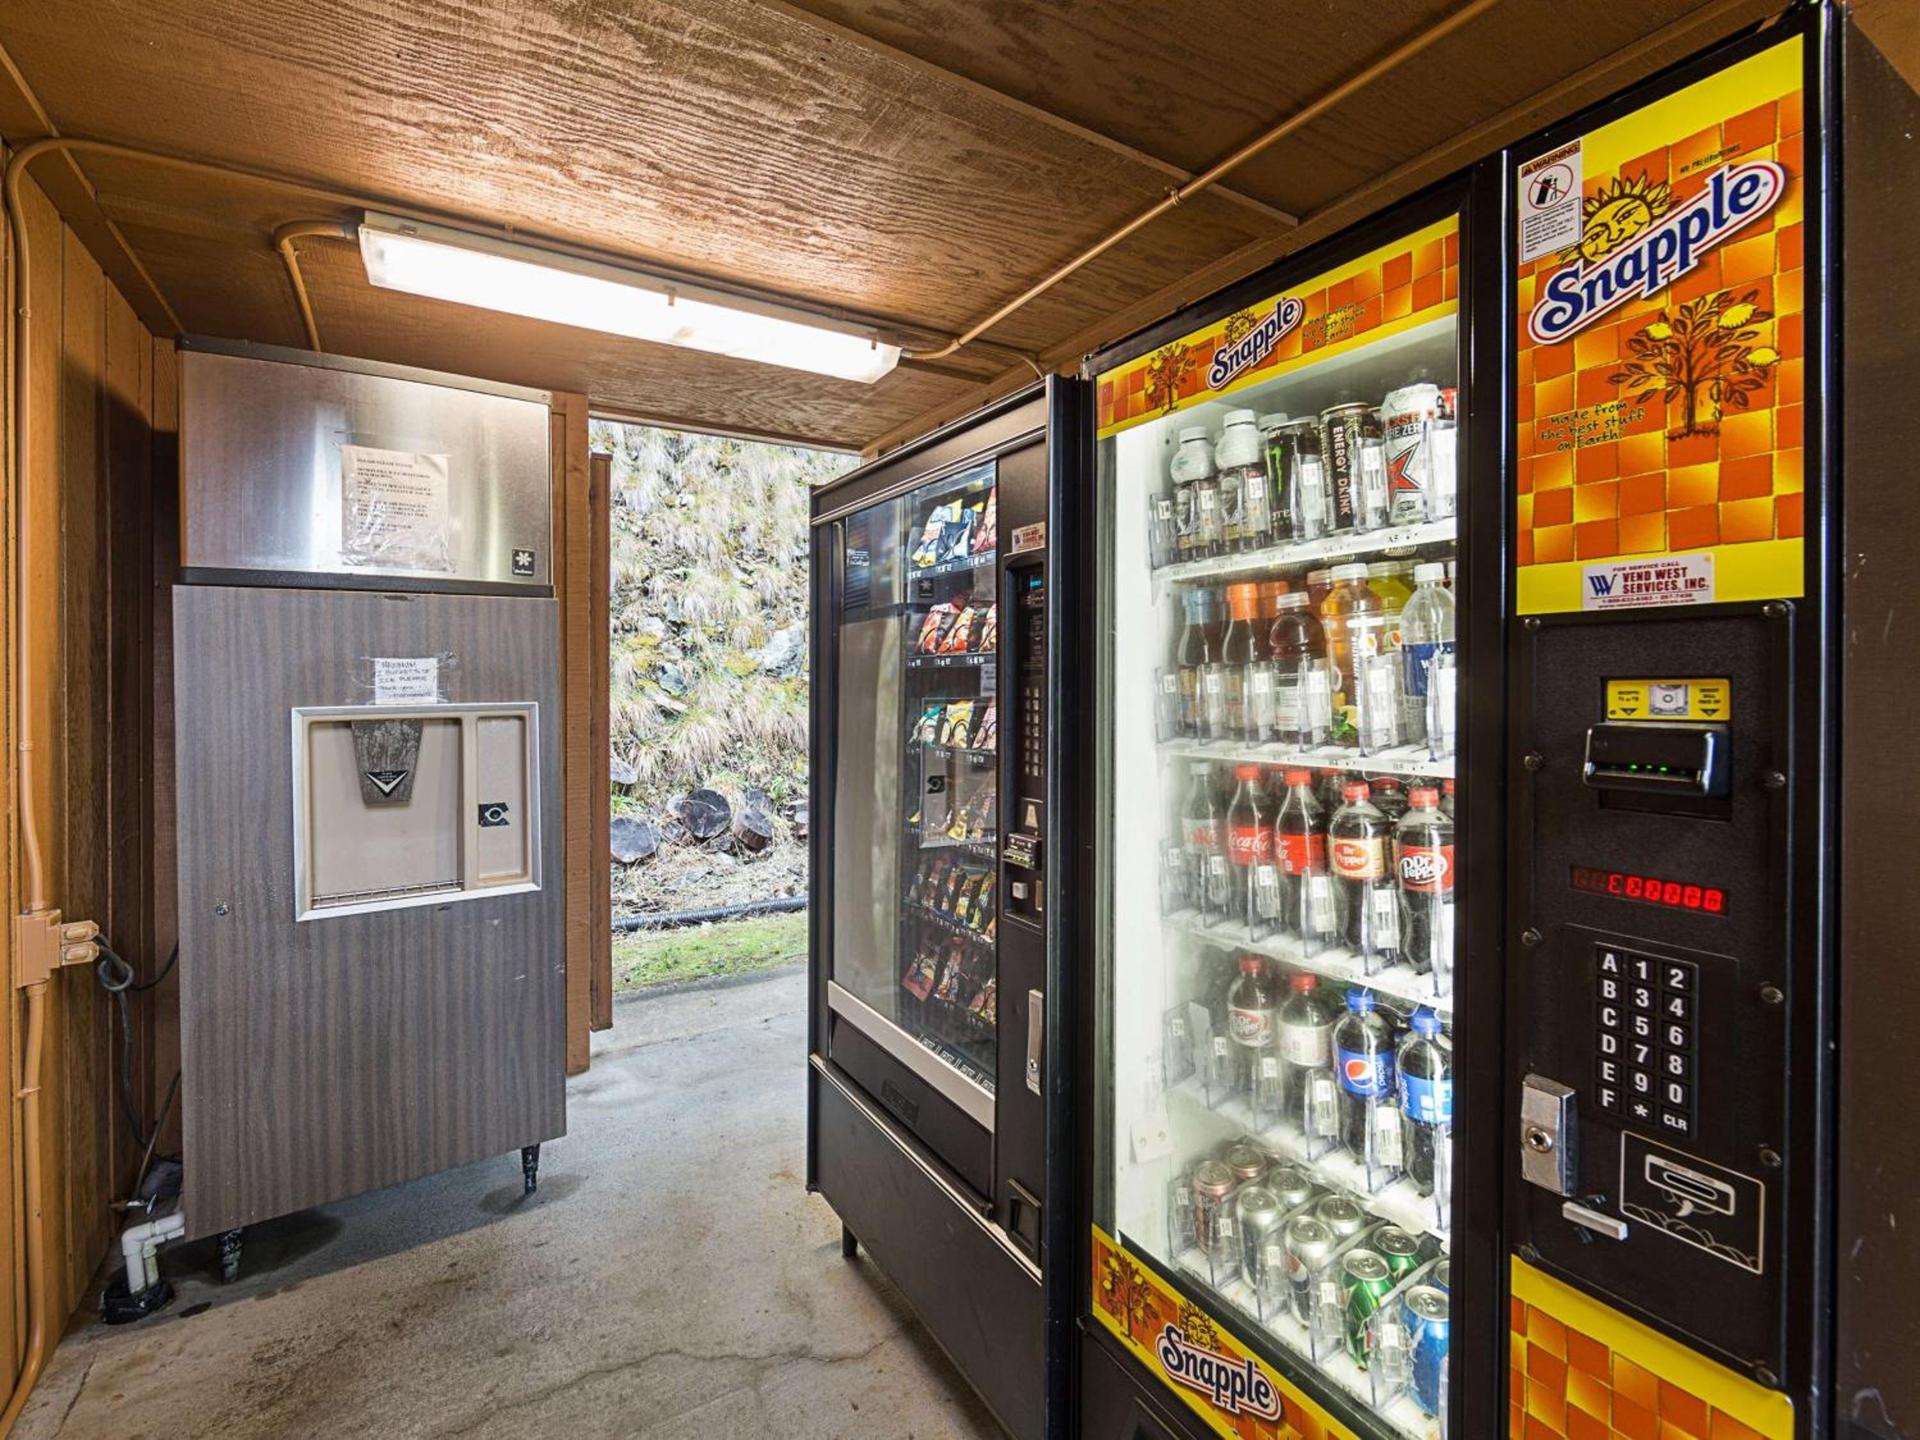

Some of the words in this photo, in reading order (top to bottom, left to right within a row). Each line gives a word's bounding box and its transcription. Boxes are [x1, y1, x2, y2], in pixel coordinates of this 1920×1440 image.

[1534, 141, 1580, 167] WARNING
[1541, 170, 1761, 333] Snapple
[1211, 300, 1296, 384] Snapple
[1541, 429, 1565, 440] the
[1567, 420, 1600, 436] best
[1604, 407, 1646, 429] stuff
[1550, 409, 1589, 425] Made
[1594, 401, 1628, 416] from
[1332, 425, 1348, 473] ENERGY
[1556, 441, 1573, 452] on
[1337, 478, 1352, 516] DRINK
[1622, 570, 1652, 583] VEND
[1655, 566, 1688, 581] WEST
[1684, 577, 1710, 590] INC.
[1602, 953, 1618, 973] A
[1635, 960, 1647, 980] 1
[1669, 968, 1685, 989] 2
[1602, 979, 1617, 999] B
[1635, 988, 1650, 1008] 3
[1669, 998, 1684, 1017] 4
[1602, 1007, 1617, 1027] C
[1635, 1016, 1649, 1036] 5
[1668, 1025, 1683, 1046] 6
[1601, 1034, 1616, 1054] D
[1634, 1043, 1649, 1064] 7
[1668, 1054, 1683, 1075] 8
[1601, 1061, 1616, 1083] E
[1634, 1072, 1648, 1093] 9
[1668, 1083, 1683, 1104] 0
[1601, 1088, 1615, 1107] F
[1662, 1113, 1688, 1132] CLR
[1161, 1324, 1271, 1410] Snapple
